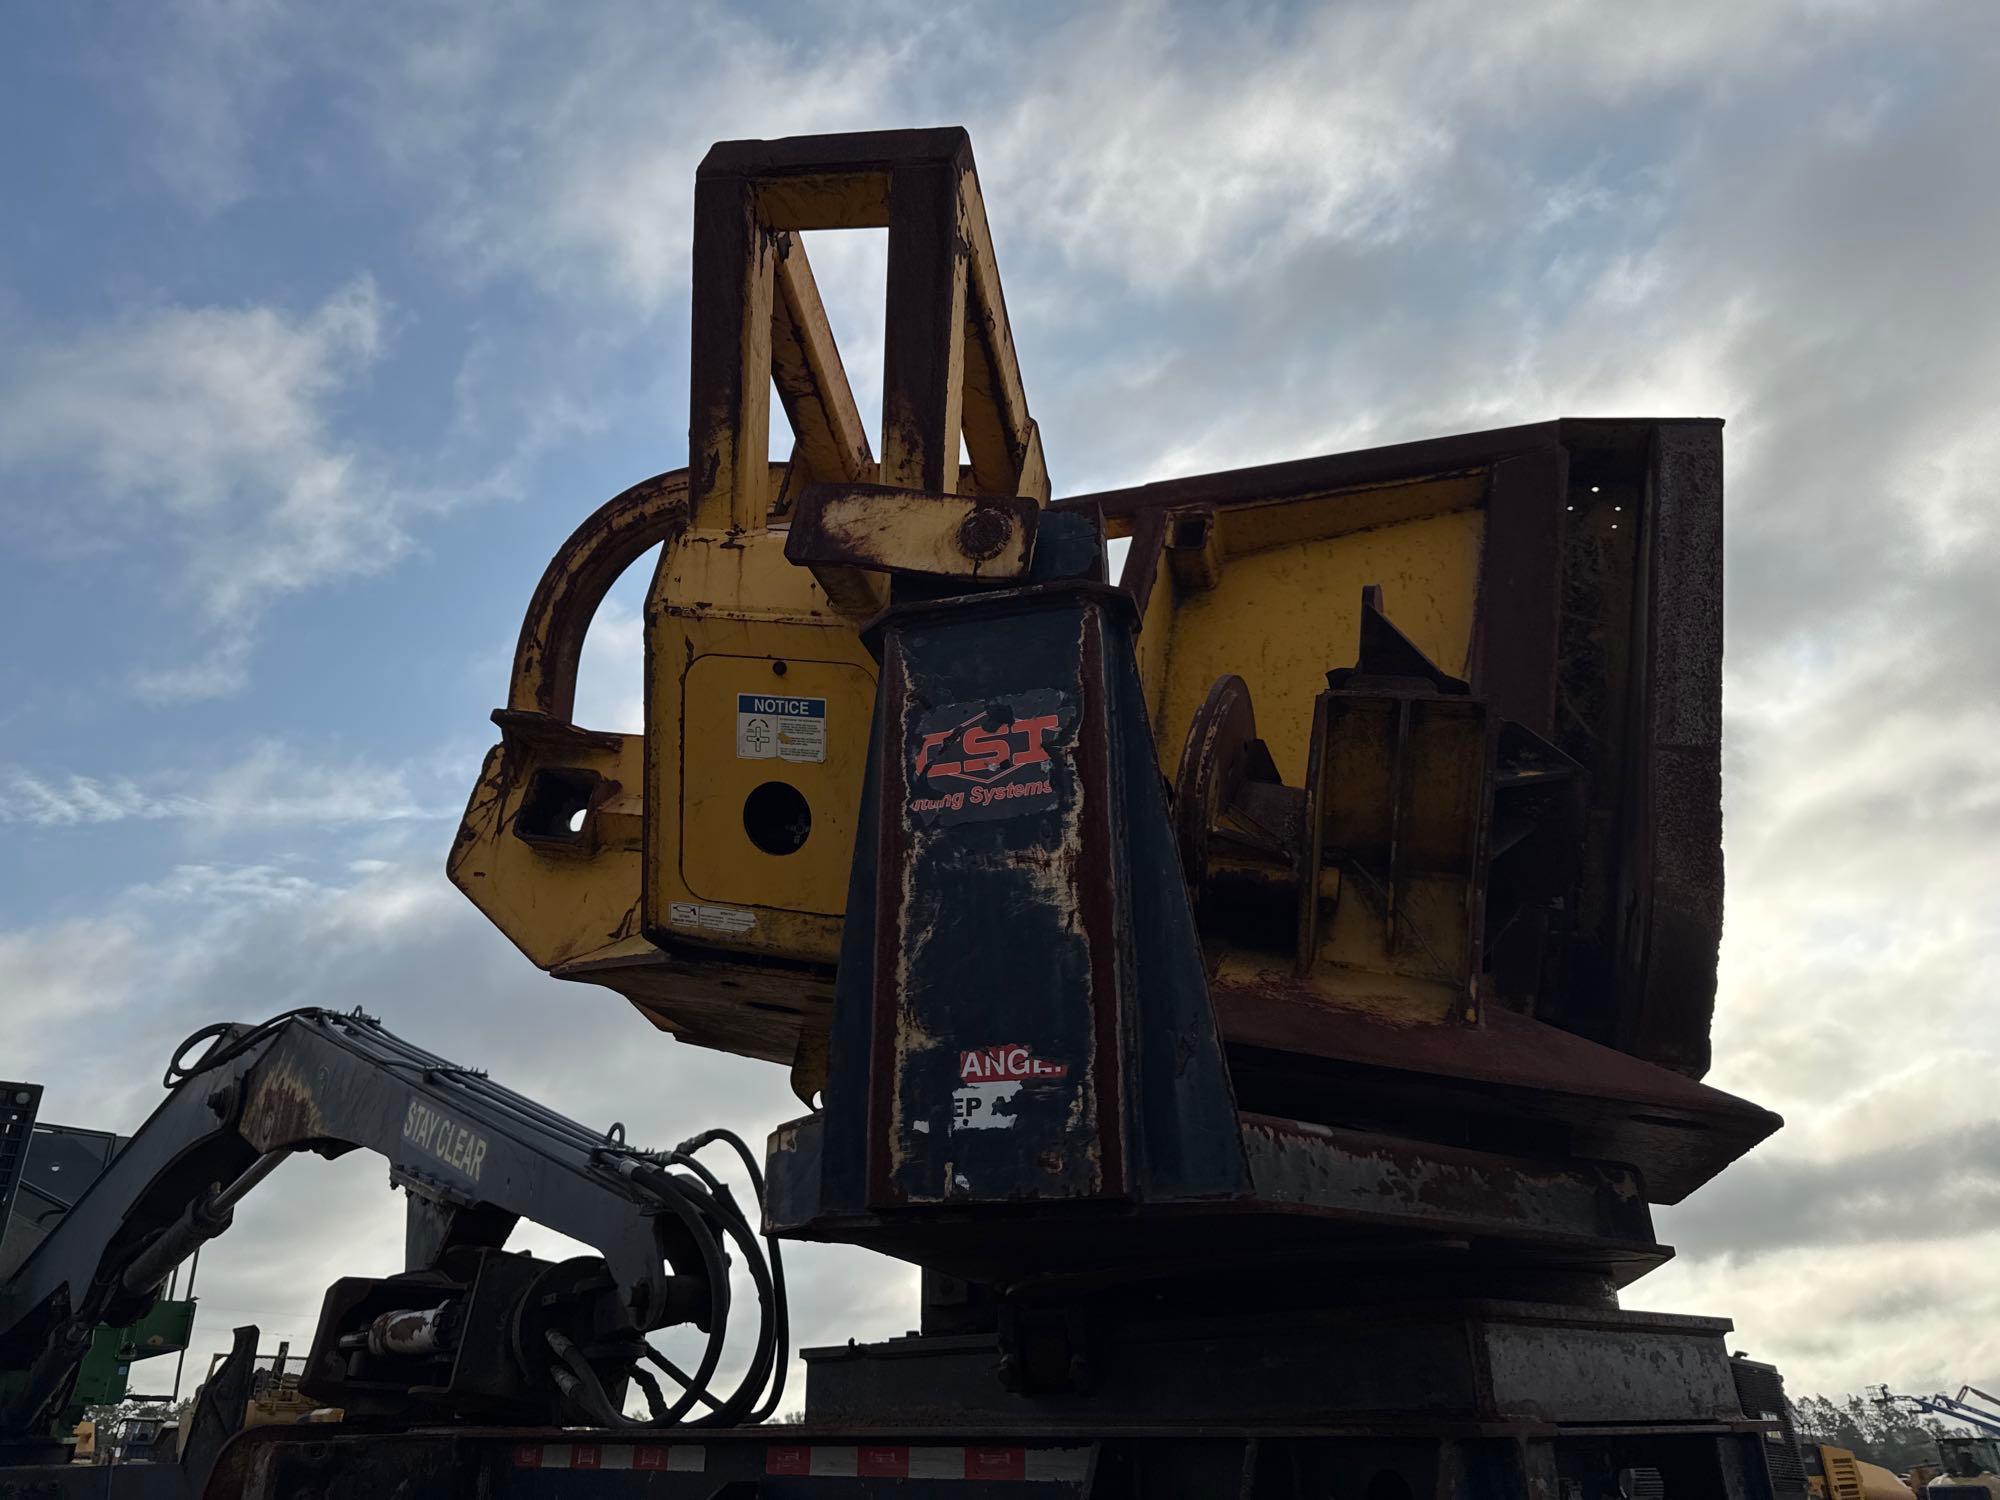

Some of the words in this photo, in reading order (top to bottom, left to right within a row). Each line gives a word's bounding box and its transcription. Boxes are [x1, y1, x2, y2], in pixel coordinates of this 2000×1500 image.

[754, 699, 809, 715] NOTICE
[970, 780, 1053, 806] Systems
[404, 1101, 440, 1149] STAY
[436, 1120, 487, 1181] CLEAR
